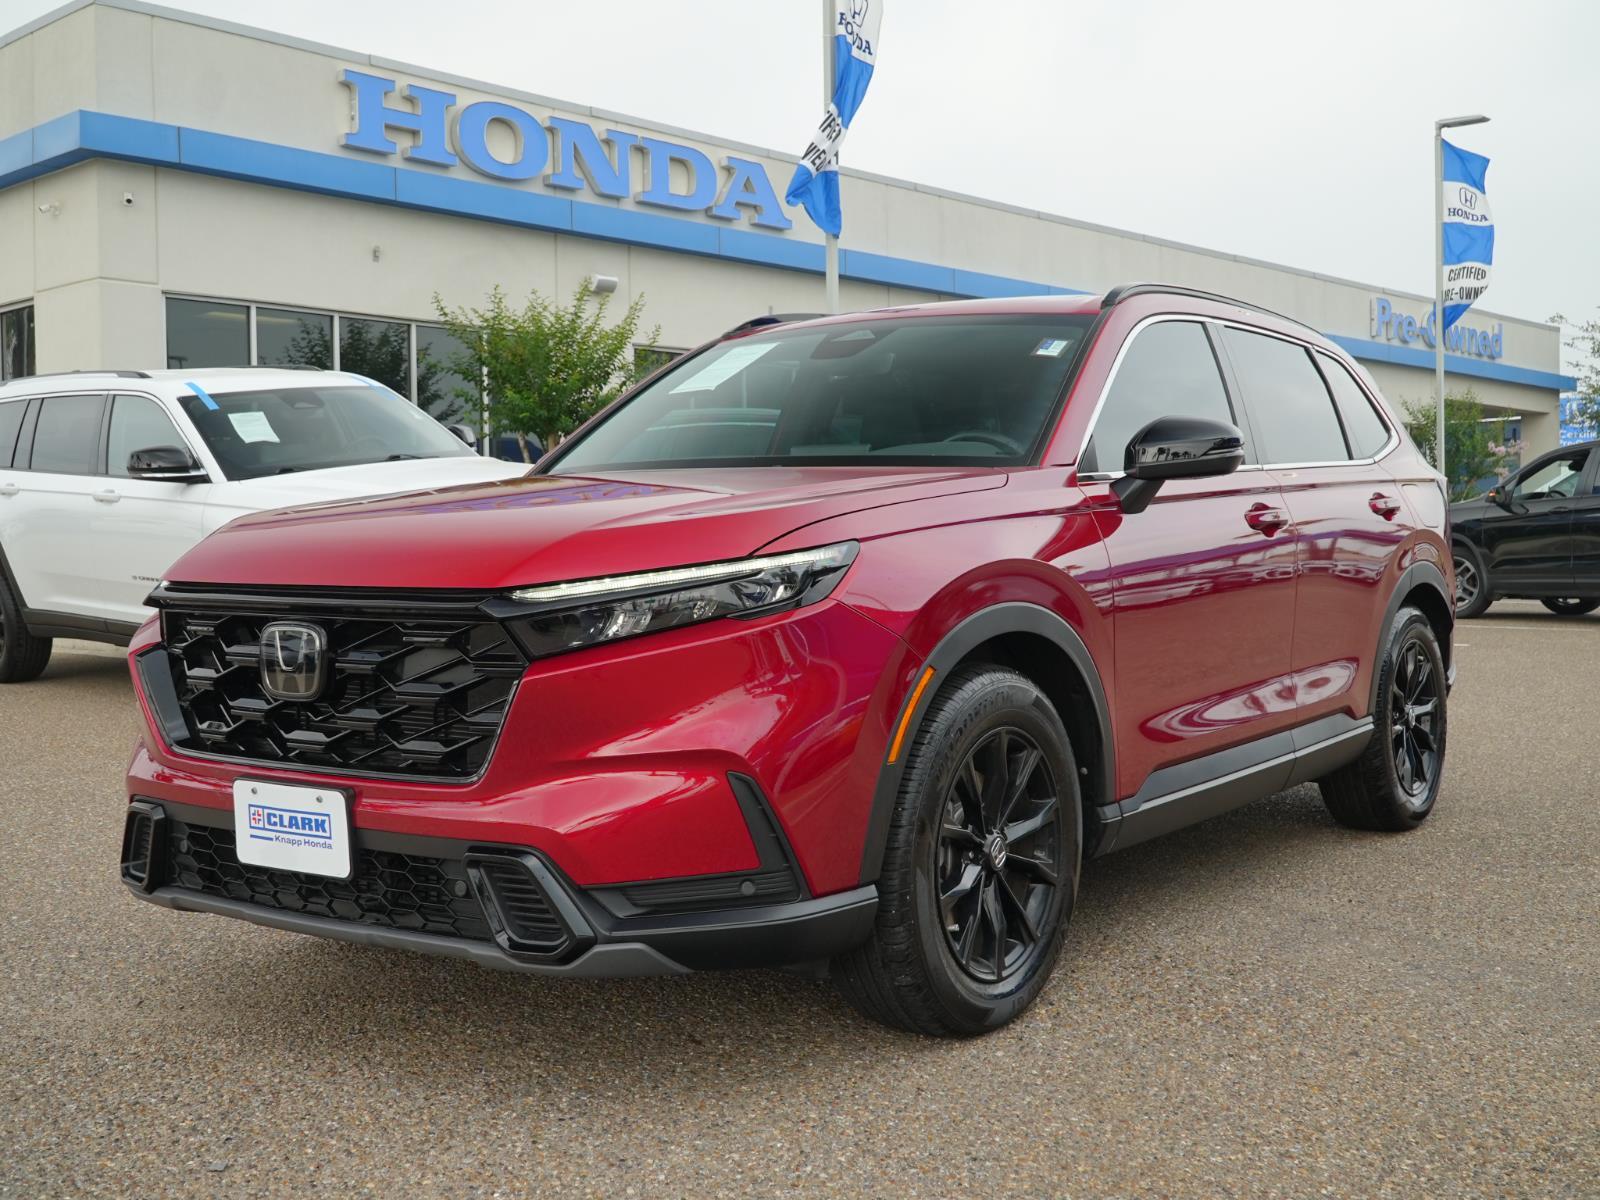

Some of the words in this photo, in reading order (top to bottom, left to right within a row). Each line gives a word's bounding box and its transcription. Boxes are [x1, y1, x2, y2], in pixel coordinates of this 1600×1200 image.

[338, 69, 793, 231] HONDA
[1447, 207, 1488, 222] HONDA
[1447, 266, 1487, 282] CERTIFIED
[266, 812, 327, 833] CLARK
[275, 835, 302, 846] Knapp
[303, 838, 333, 850] Honda
